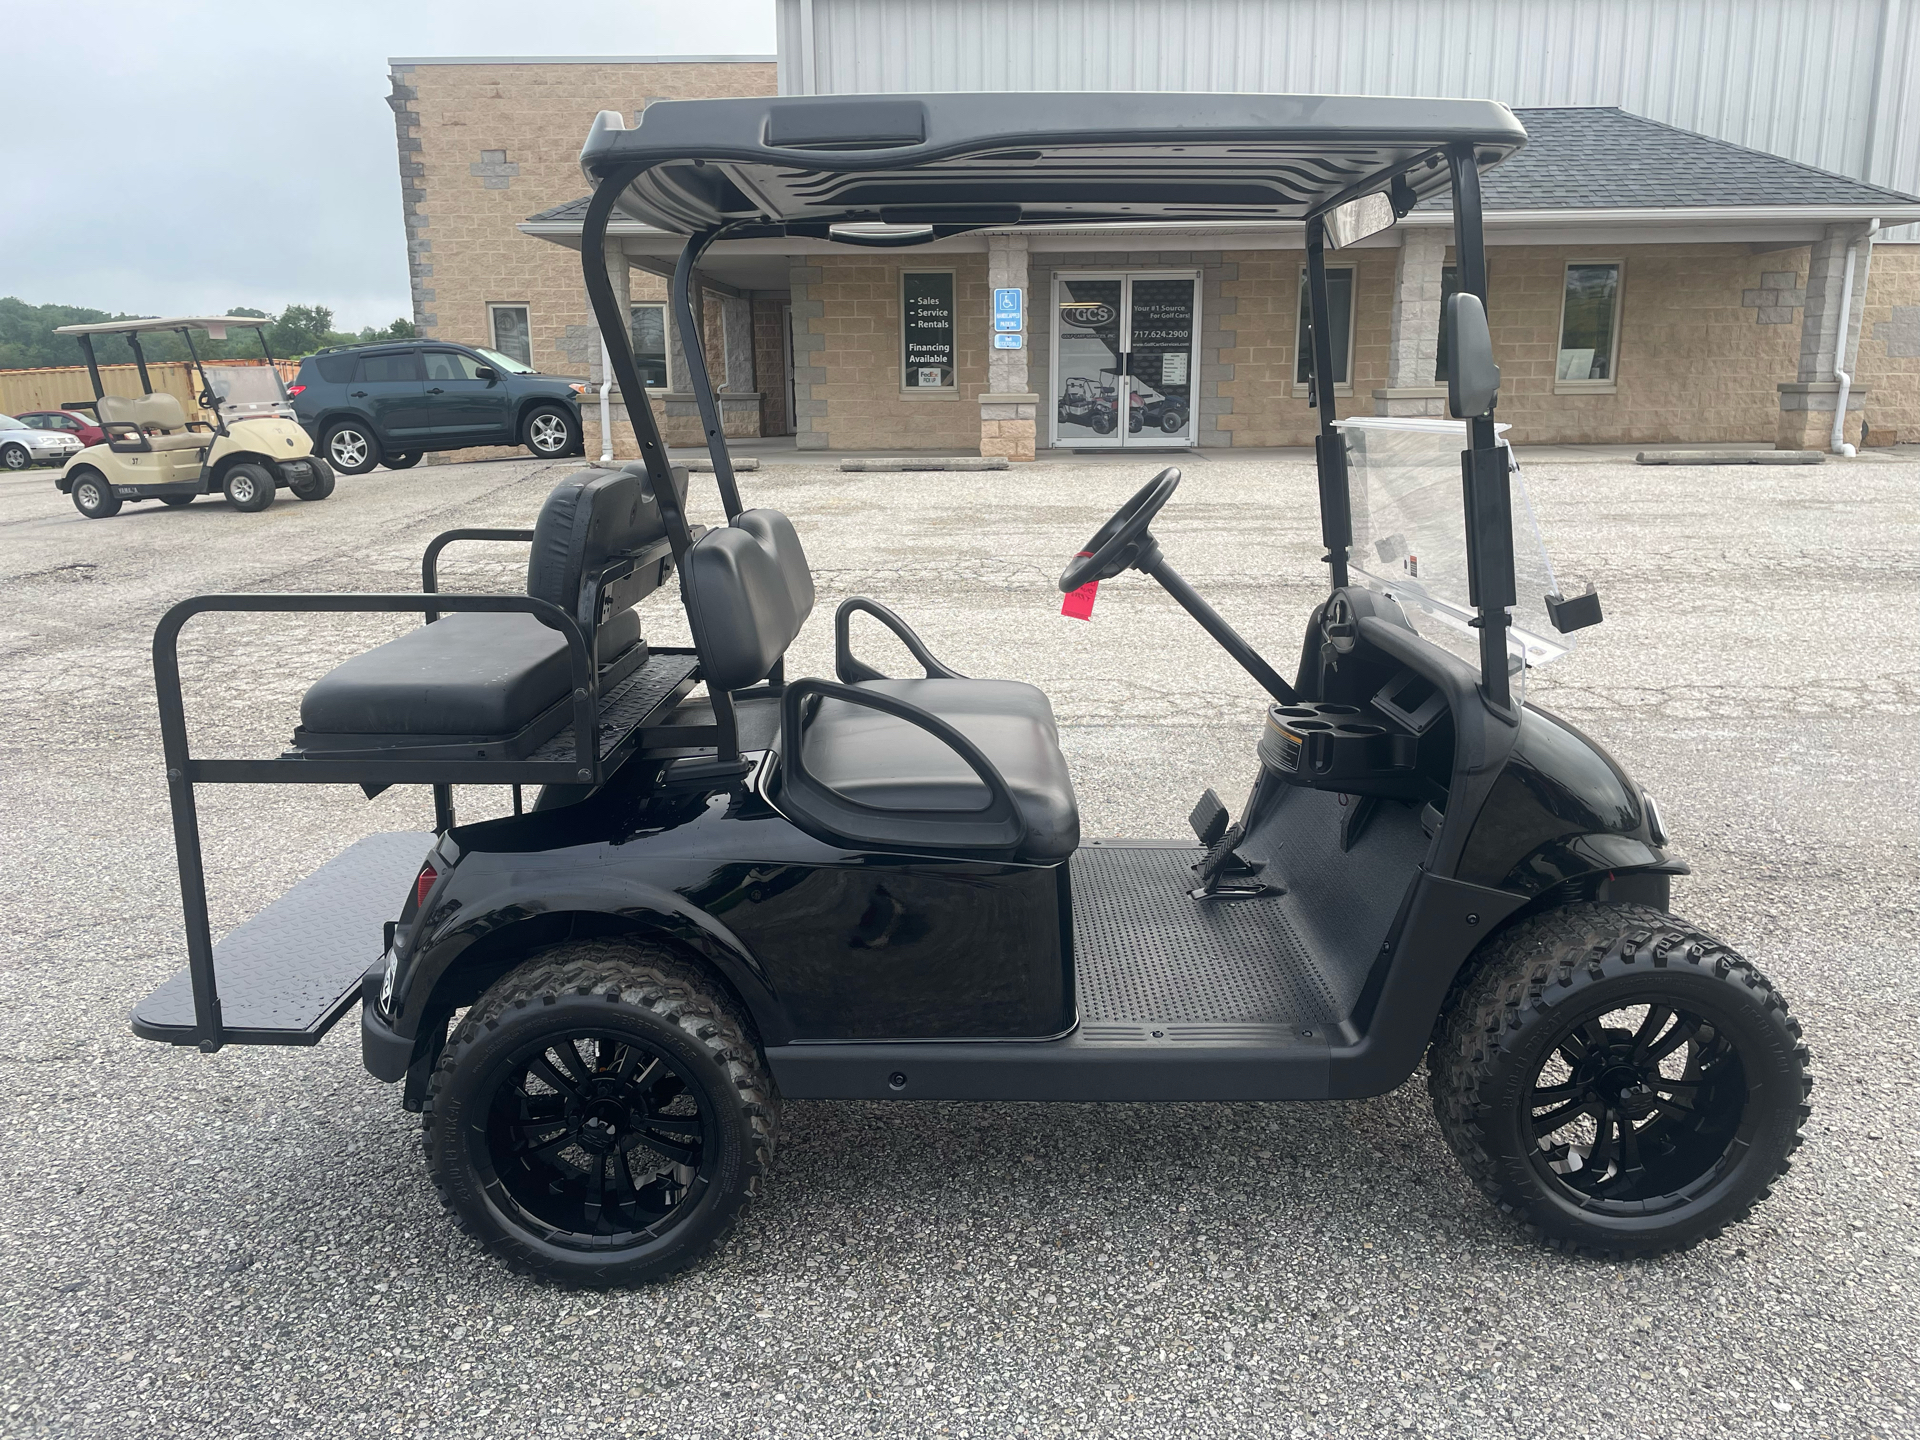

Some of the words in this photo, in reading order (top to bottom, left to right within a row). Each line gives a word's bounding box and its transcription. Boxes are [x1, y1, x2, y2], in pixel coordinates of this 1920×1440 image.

[917, 296, 940, 305] Sales
[917, 308, 949, 317] Service
[1161, 304, 1186, 312] Source
[1075, 307, 1108, 321] GCS
[917, 320, 949, 328] Rentals
[1133, 330, 1189, 338] 717.624.2900
[909, 343, 950, 353] Financing
[909, 354, 948, 363] Available
[612, 1012, 660, 1033] DESERT
[661, 1032, 697, 1061] EAGLE
